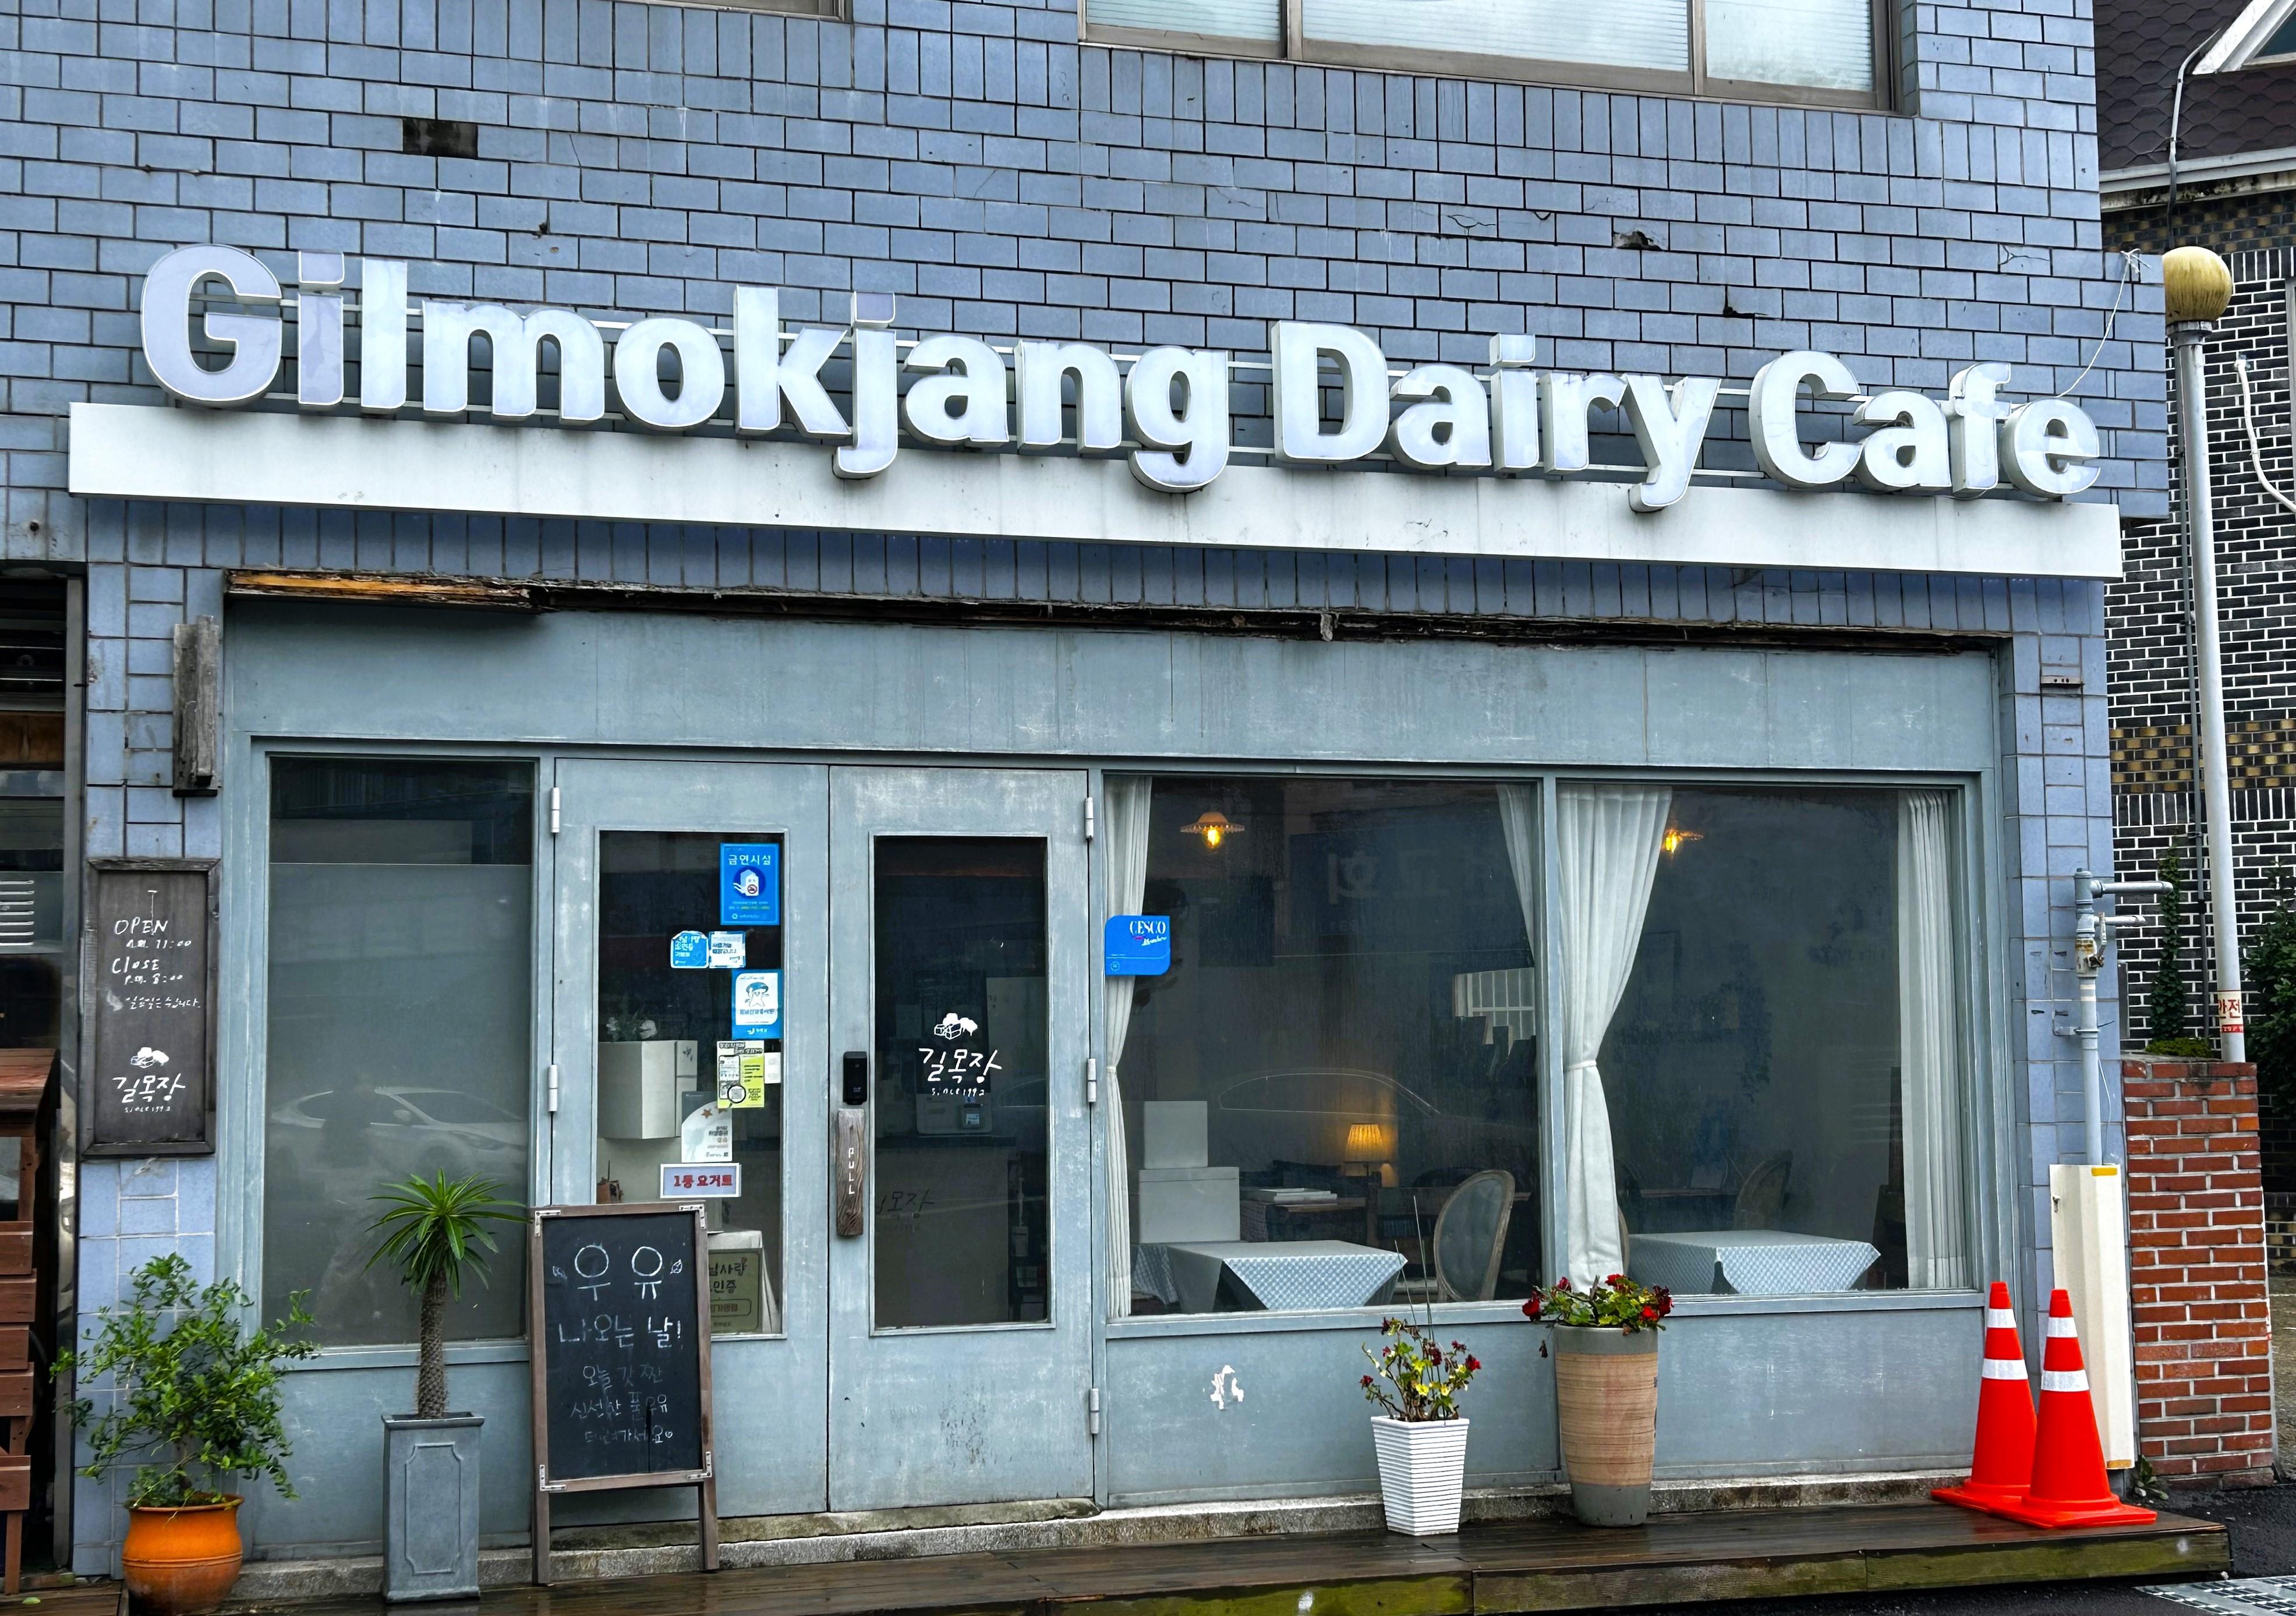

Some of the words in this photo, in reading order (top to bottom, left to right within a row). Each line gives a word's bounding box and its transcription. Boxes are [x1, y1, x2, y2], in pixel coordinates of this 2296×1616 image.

[141, 243, 1229, 494] Gilmokjang
[1271, 320, 1722, 513] Dairy
[1749, 350, 2102, 500] Cafe
[728, 854, 771, 865] 금연시설
[114, 917, 168, 935] OPEN
[1130, 921, 1166, 935] CESCO
[919, 1048, 1002, 1083] 길목장
[112, 1073, 186, 1103] 길목장
[696, 1175, 732, 1187] 요거트
[574, 1244, 663, 1301] 우유
[559, 1314, 634, 1348] 나오는
[583, 1364, 613, 1390] 오늘
